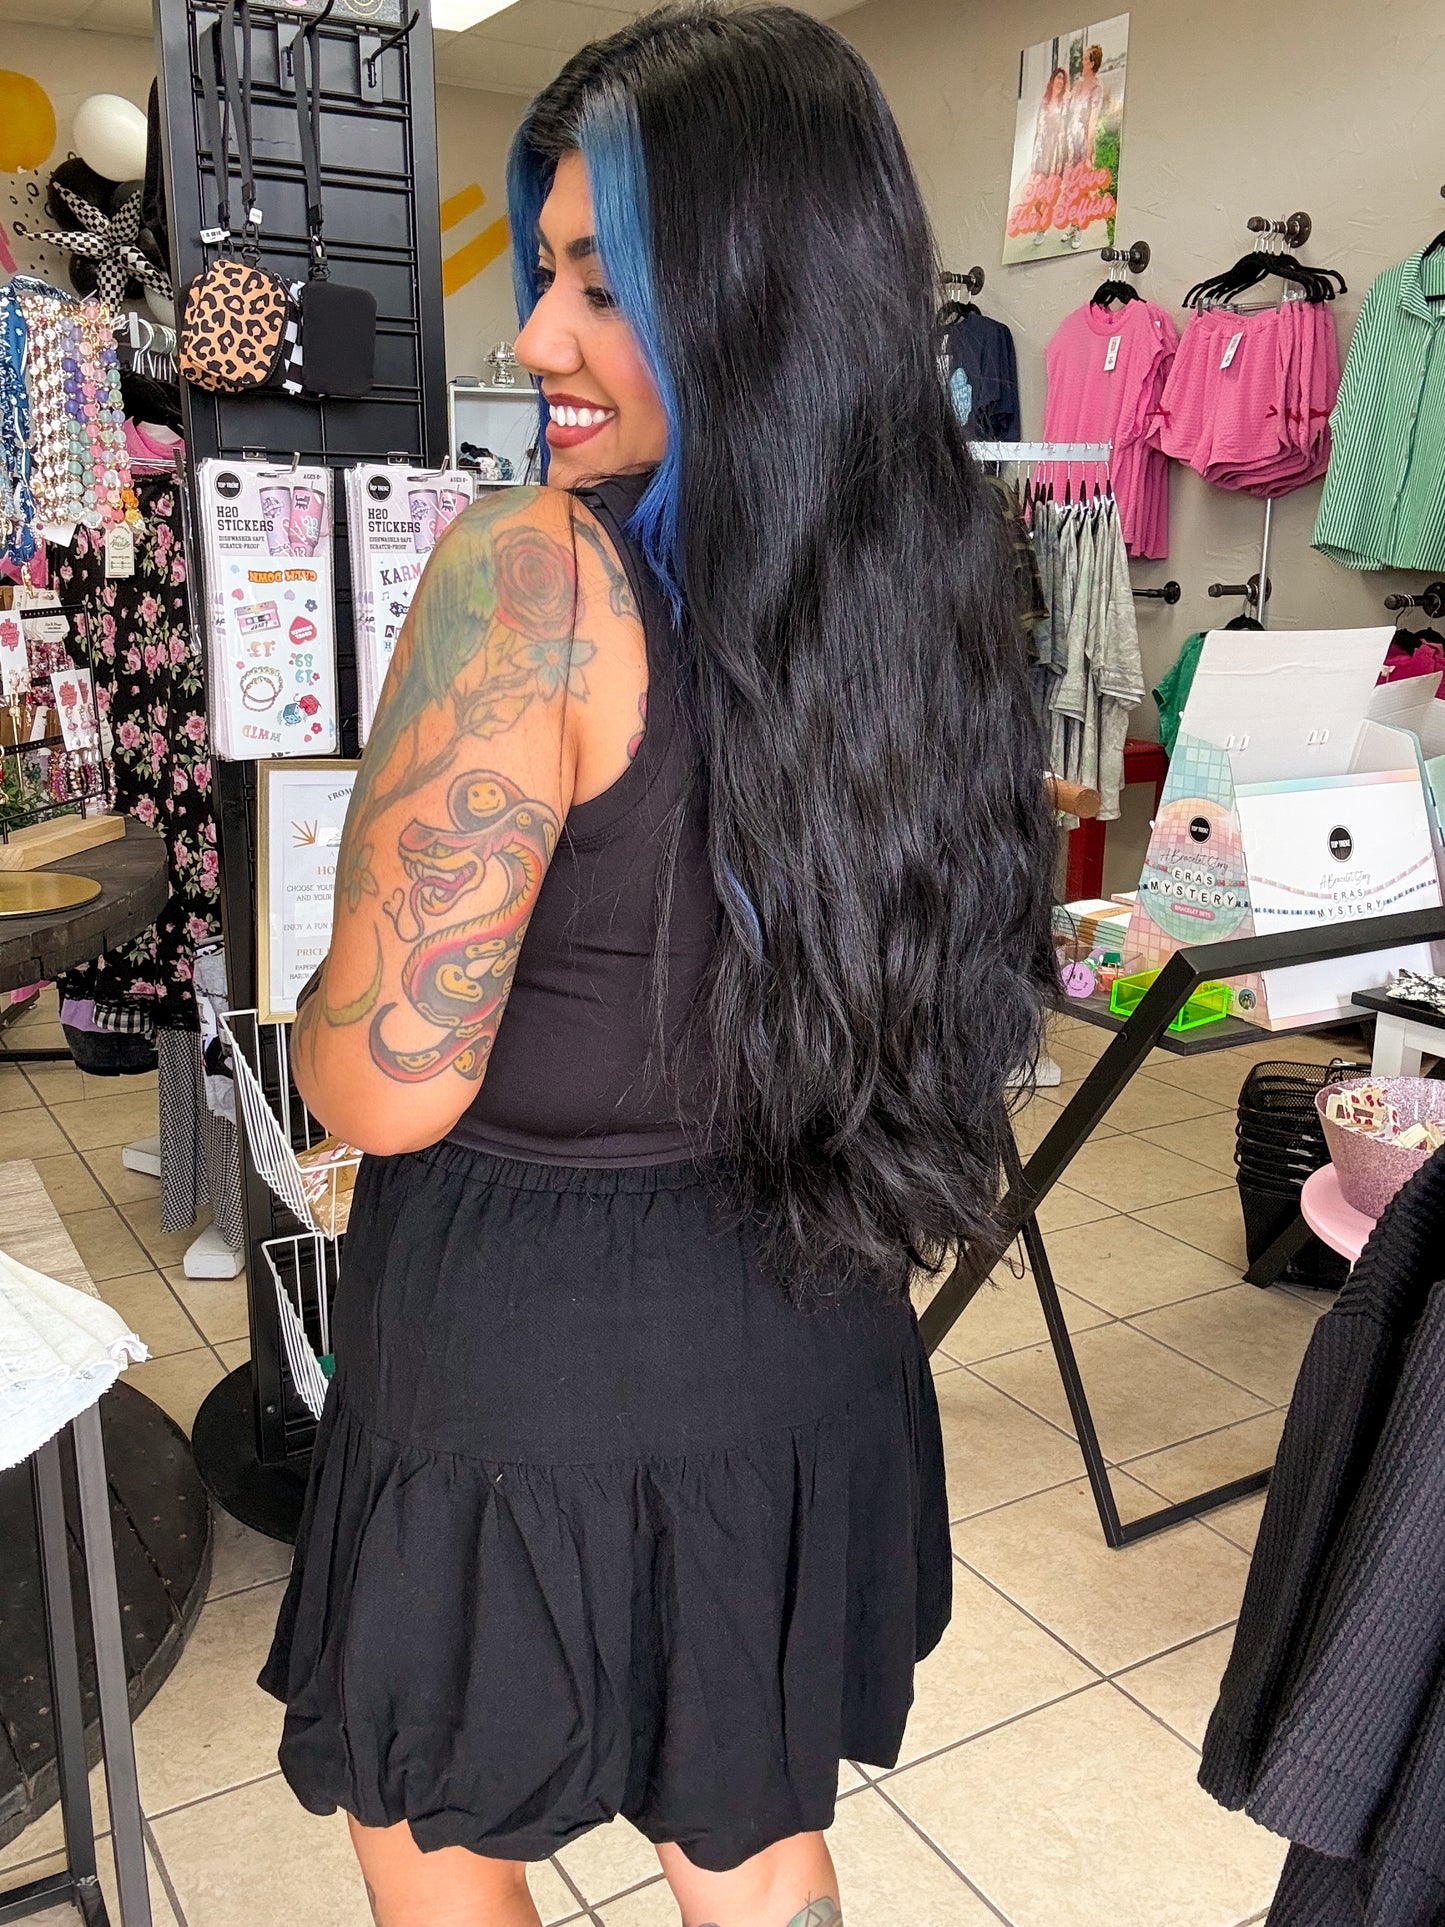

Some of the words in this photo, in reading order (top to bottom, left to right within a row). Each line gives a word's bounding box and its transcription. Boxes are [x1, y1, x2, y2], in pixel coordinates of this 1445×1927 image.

[1022, 173, 1061, 204] Self
[1063, 162, 1110, 189] Love
[217, 520, 274, 532] STICKERS
[368, 521, 421, 533] STICKERS
[248, 570, 283, 584] DOWN
[284, 568, 318, 582] CALM
[1160, 848, 1170, 860] A
[1171, 848, 1207, 865] Bracelet
[1208, 856, 1229, 875] Story
[1174, 870, 1213, 885] ERAS
[1150, 881, 1234, 906] MYSTERY
[1333, 888, 1363, 900] ERAS
[1174, 904, 1199, 914] BRACELET
[1199, 910, 1212, 918] SETS
[1318, 900, 1381, 918] MYSTERY
[296, 948, 322, 956] PRICE
